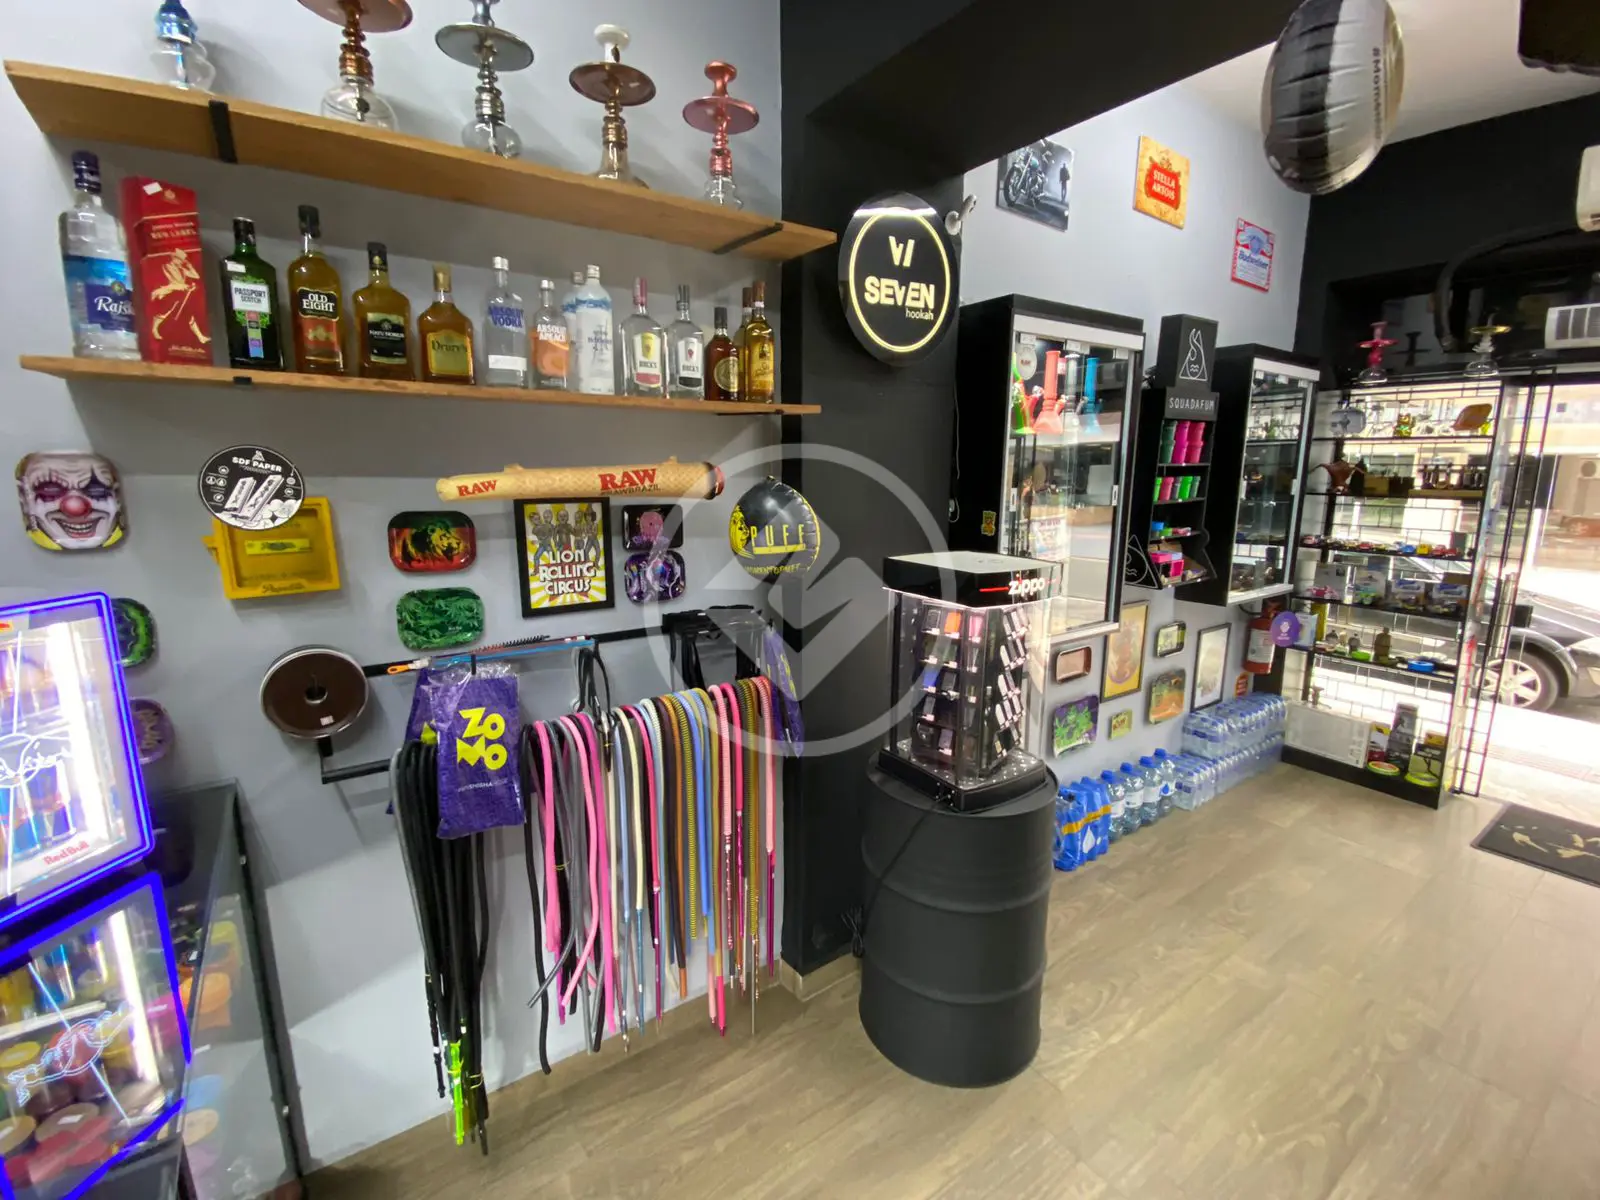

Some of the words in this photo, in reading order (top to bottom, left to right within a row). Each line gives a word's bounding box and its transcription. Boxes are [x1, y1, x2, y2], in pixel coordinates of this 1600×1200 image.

[1153, 168, 1176, 190] STELLA
[1151, 182, 1176, 201] ARTOIS
[234, 286, 267, 299] PASSPORT
[308, 292, 328, 304] OLD
[864, 275, 935, 309] SEVEN
[302, 298, 335, 313] EIGHT
[488, 303, 525, 318] ABSOLUT
[905, 307, 934, 321] hookah
[491, 314, 524, 329] VODKA
[1168, 397, 1215, 411] SQUADAFUM
[231, 456, 251, 466] SDF
[252, 459, 283, 473] PAPER
[456, 479, 499, 497] RAW
[598, 467, 657, 492] RAW
[750, 522, 805, 547] PUFF
[547, 548, 585, 565] LION
[539, 561, 596, 582] ROLLING
[544, 578, 592, 595] CIRCUS
[1008, 573, 1046, 598] zippo
